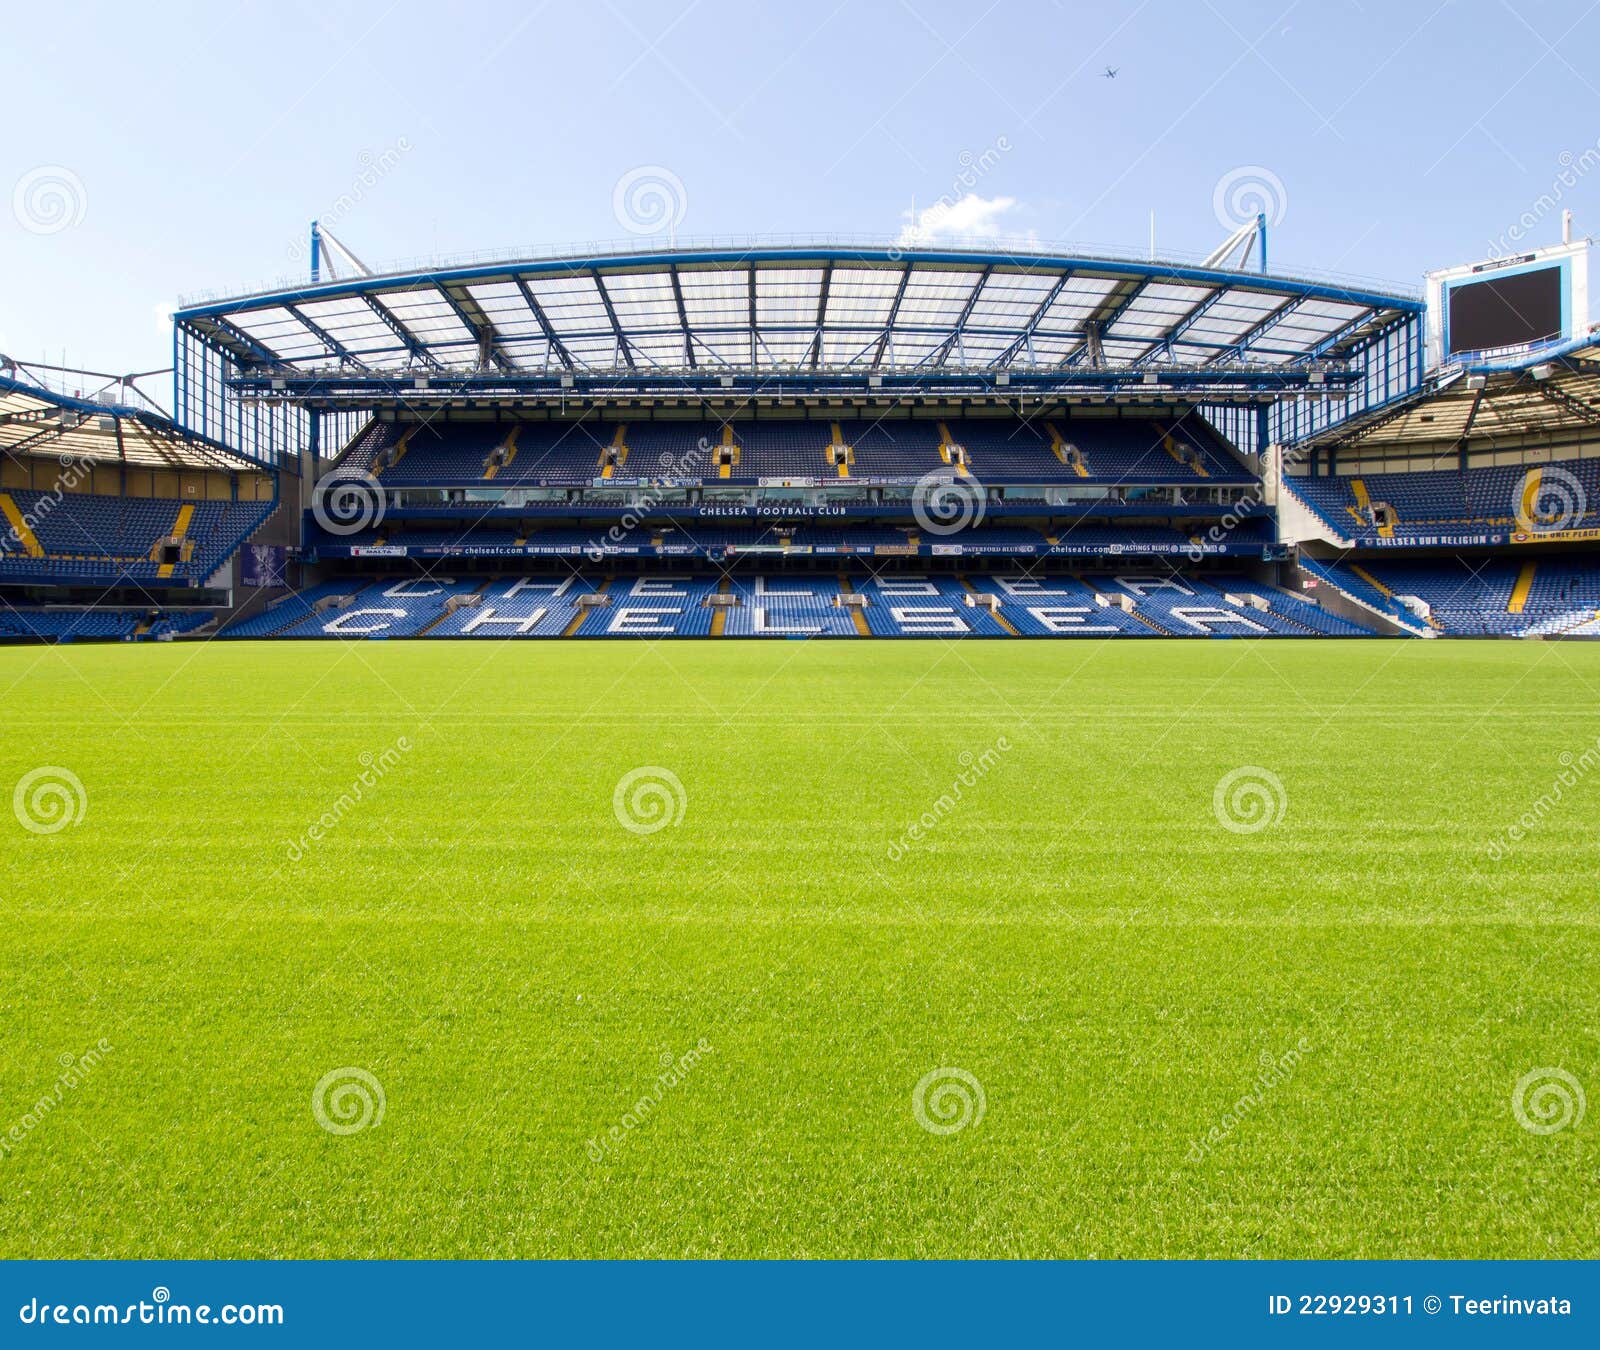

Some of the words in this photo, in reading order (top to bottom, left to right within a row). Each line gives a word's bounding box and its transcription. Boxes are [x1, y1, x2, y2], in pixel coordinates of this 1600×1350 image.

[1480, 344, 1530, 359] SAMSUNG
[699, 507, 747, 516] CHELSEA
[757, 507, 814, 516] FOOTBALL
[818, 507, 847, 516] CLUB
[1376, 537, 1416, 546] CHELSEA
[1441, 534, 1487, 545] RELIGION
[464, 546, 524, 554] chelseafc.com
[1050, 545, 1110, 554] chelseafc.com
